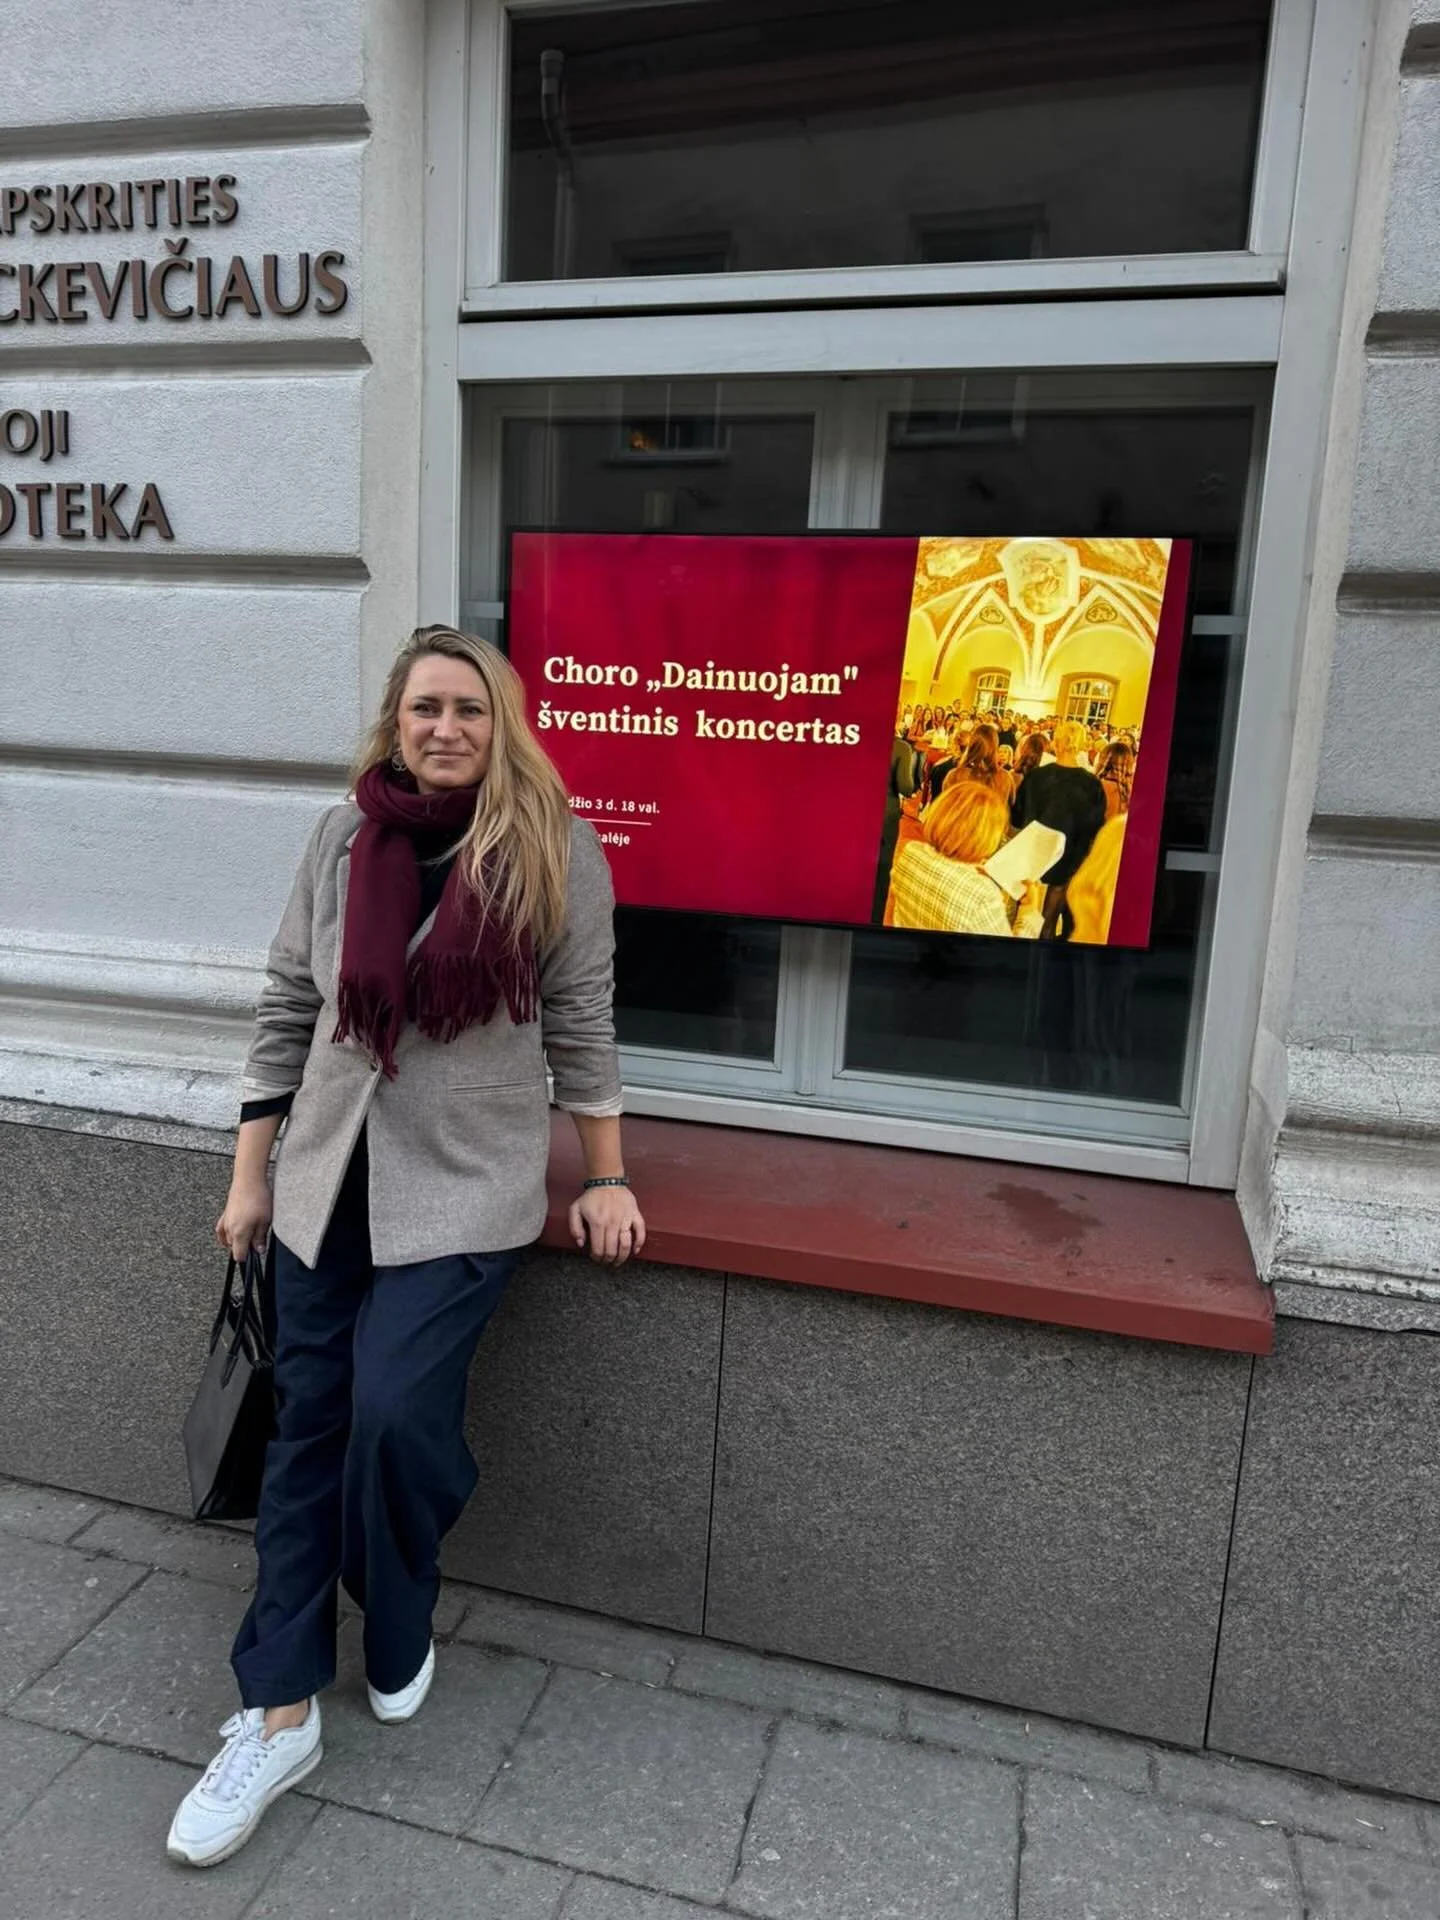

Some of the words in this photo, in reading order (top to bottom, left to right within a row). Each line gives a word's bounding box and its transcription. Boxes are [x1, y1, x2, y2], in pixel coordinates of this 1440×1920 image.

[0, 174, 238, 234] PSKRITIES
[0, 408, 69, 462] OJI
[544, 656, 638, 686] Choro
[537, 701, 679, 736] šventinis
[695, 710, 860, 745] koncertas
[595, 798, 603, 810] 3
[606, 799, 618, 811] d.
[621, 800, 636, 813] 18
[638, 801, 660, 814] val.
[598, 832, 631, 847] alėje
